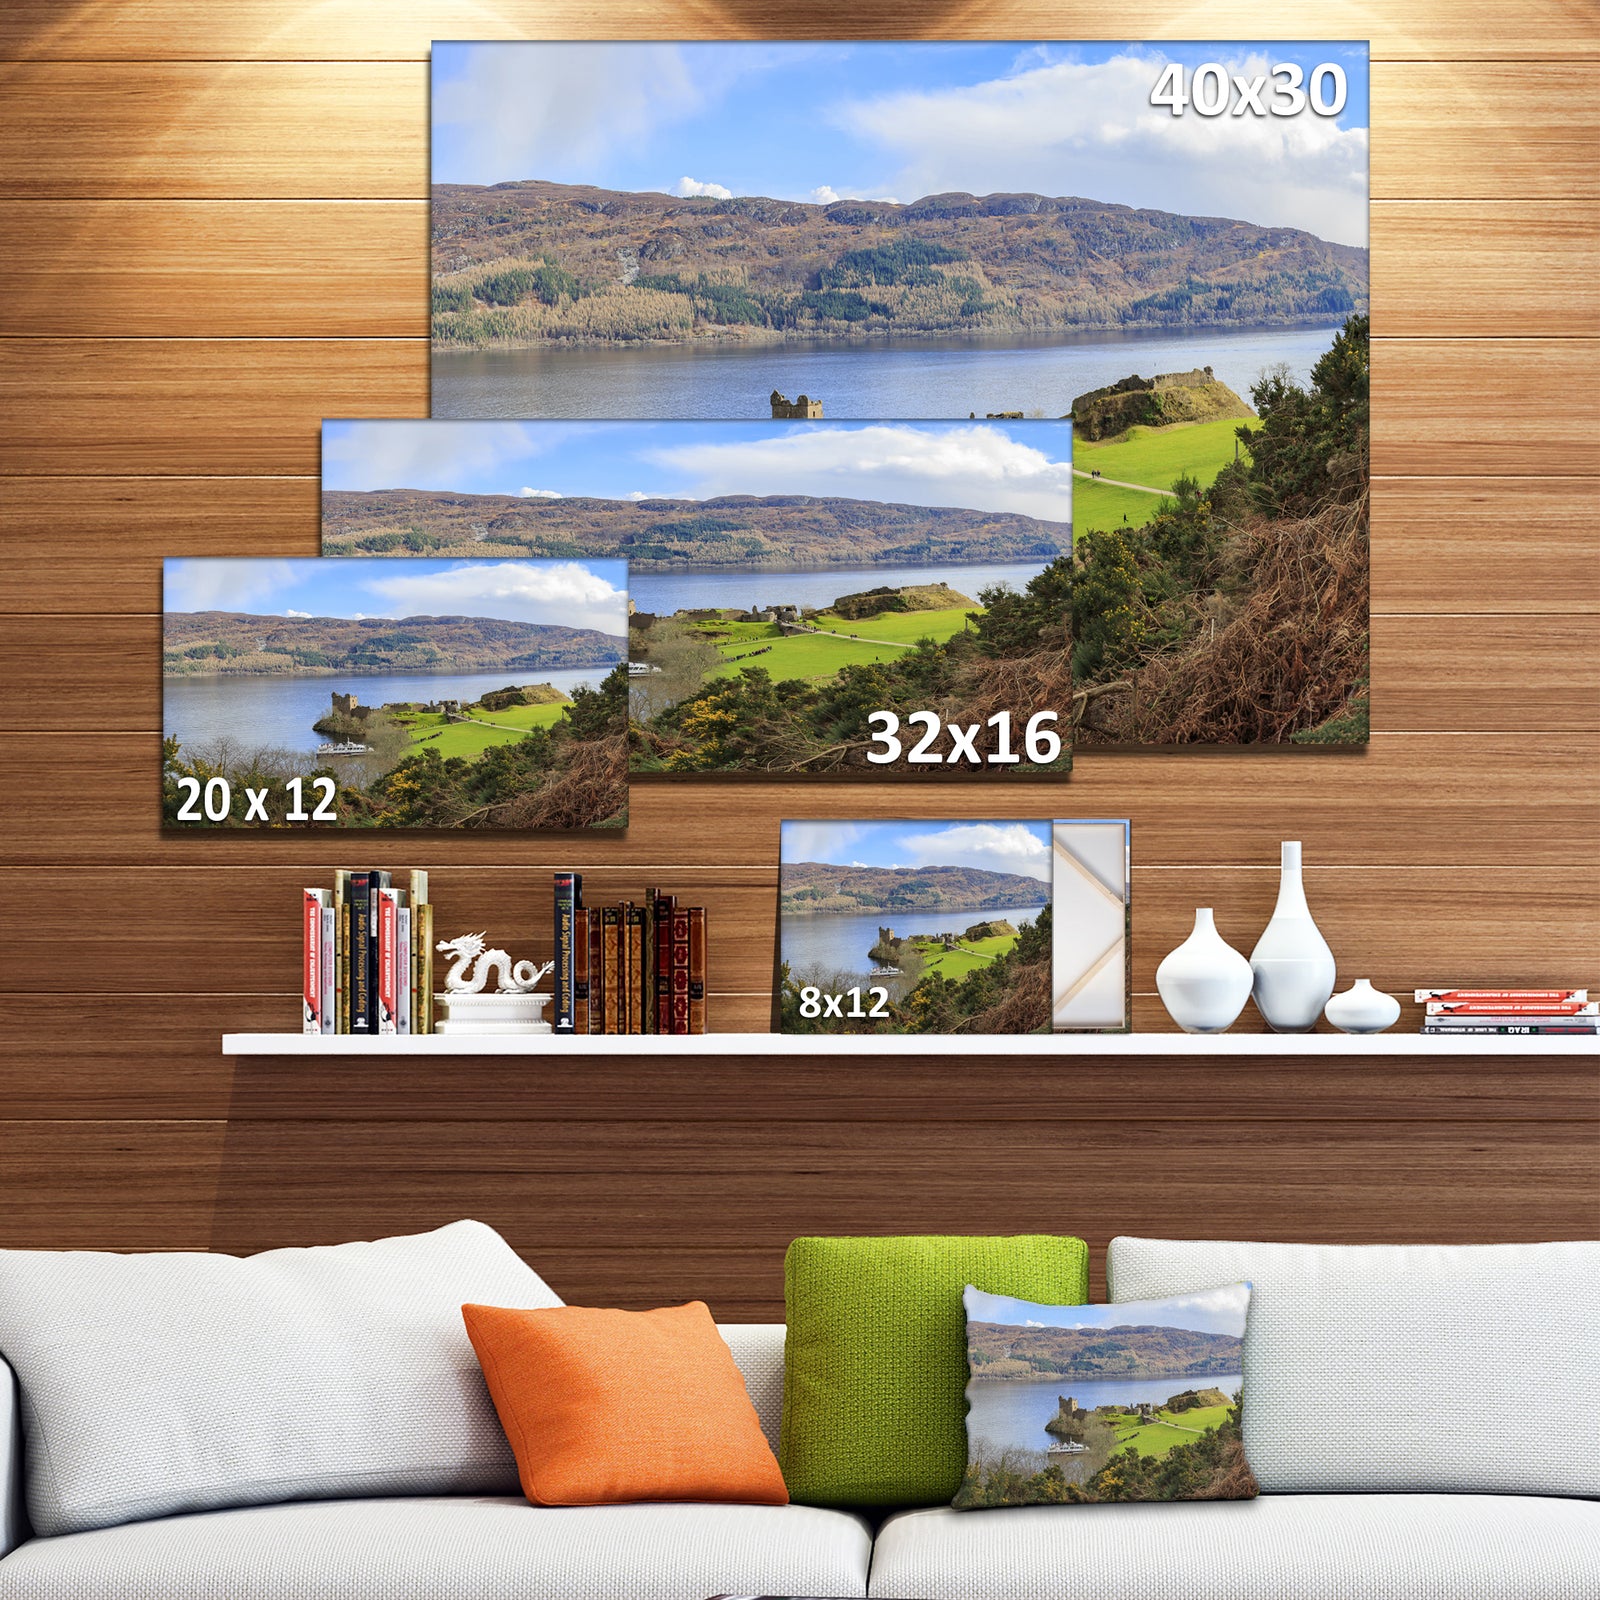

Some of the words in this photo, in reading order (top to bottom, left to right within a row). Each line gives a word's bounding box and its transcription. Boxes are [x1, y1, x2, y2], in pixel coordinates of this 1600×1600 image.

[358, 913, 367, 930] Audio
[561, 913, 570, 930] Audio
[356, 931, 367, 949] Signal
[560, 931, 570, 949] Signal
[356, 950, 367, 980] Processing
[560, 950, 570, 980] Processing
[358, 981, 367, 991] and
[561, 981, 570, 991] and
[356, 992, 367, 1012] Coding
[560, 992, 570, 1012] Coding
